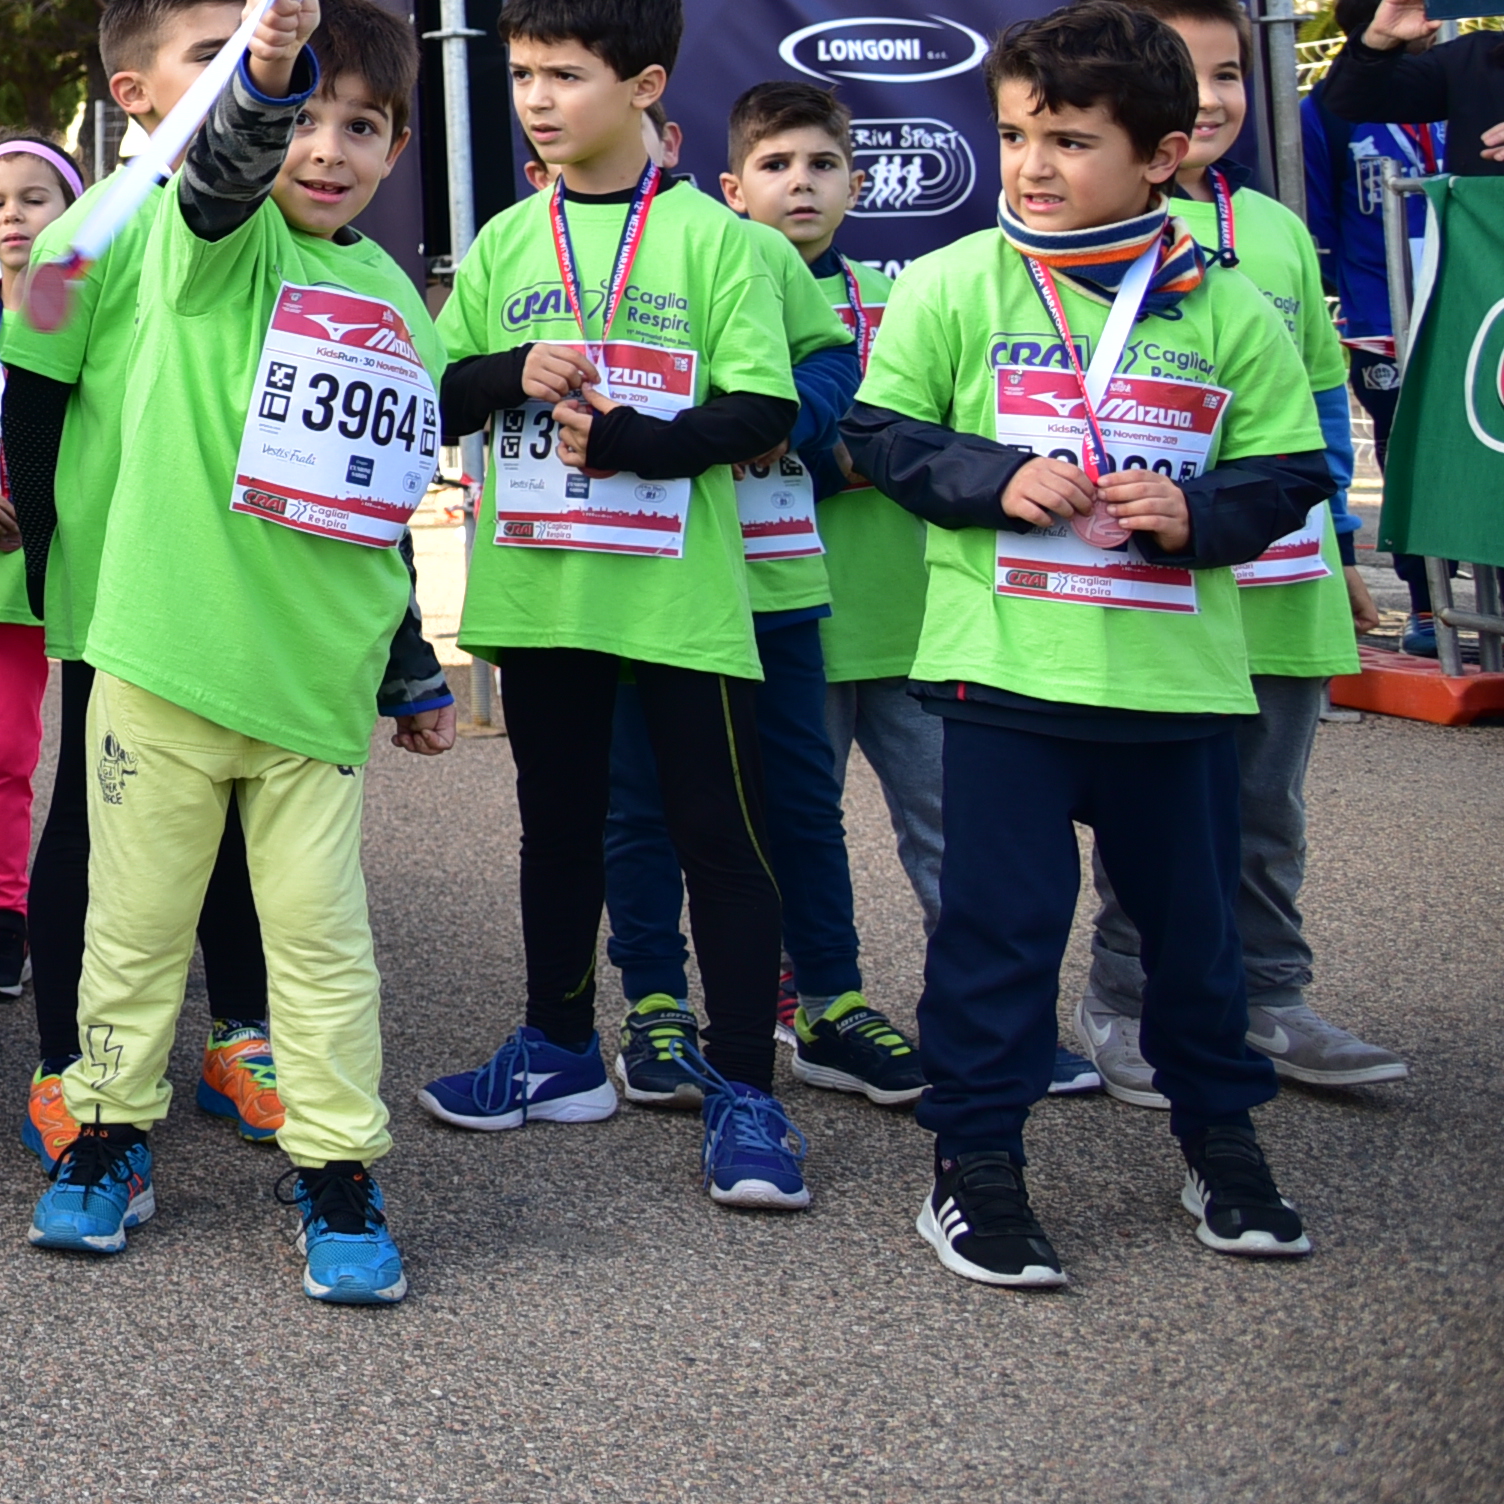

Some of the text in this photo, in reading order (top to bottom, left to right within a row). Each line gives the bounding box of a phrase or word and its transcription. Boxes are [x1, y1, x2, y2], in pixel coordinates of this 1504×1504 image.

[817, 39, 920, 61] LONGONI
[625, 214, 640, 243] MEZZA
[507, 288, 573, 325] CRAI
[1041, 285, 1067, 340] MARATONA
[315, 346, 408, 378] KidsRun 30 Novembre
[629, 392, 648, 403] 2019
[301, 372, 418, 453] 3964
[1095, 398, 1192, 427] MIZUNO
[1113, 430, 1178, 444] Novembre 2019
[261, 443, 289, 459] Vestis
[244, 489, 287, 514] CRAI
[310, 504, 350, 520] Cagliari
[308, 513, 348, 530] Respira
[546, 522, 572, 533] Cagliari
[546, 530, 572, 539] Respira
[1006, 570, 1047, 588] CRAI
[1070, 574, 1112, 587] Cagliari
[1070, 585, 1112, 596] Respira
